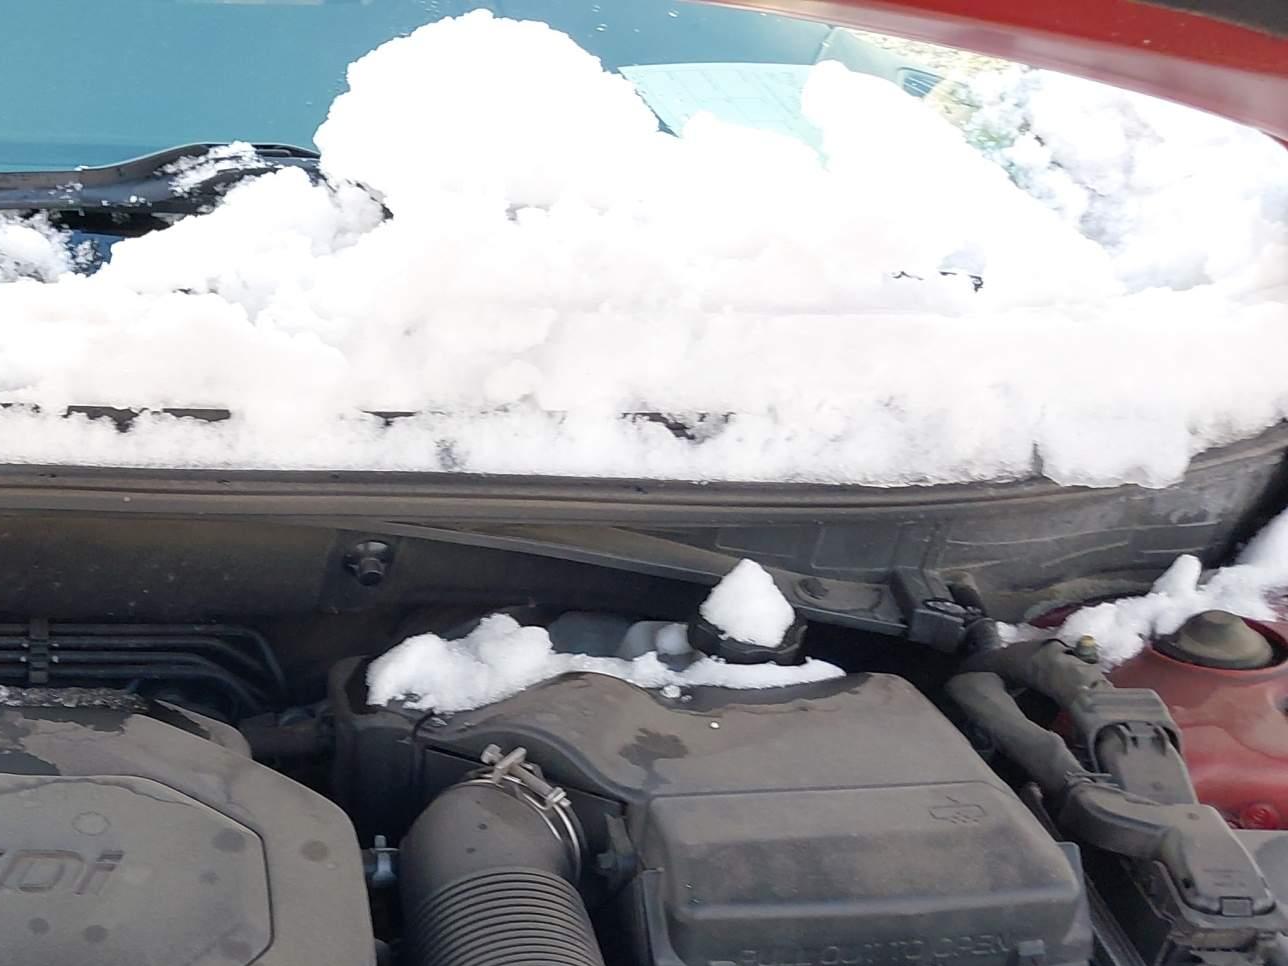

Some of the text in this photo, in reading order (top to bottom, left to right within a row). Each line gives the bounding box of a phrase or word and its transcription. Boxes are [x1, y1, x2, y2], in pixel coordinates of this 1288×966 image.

[820, 943, 881, 966] OUT
[889, 939, 924, 960] TO
[933, 934, 1011, 958] OPEN
